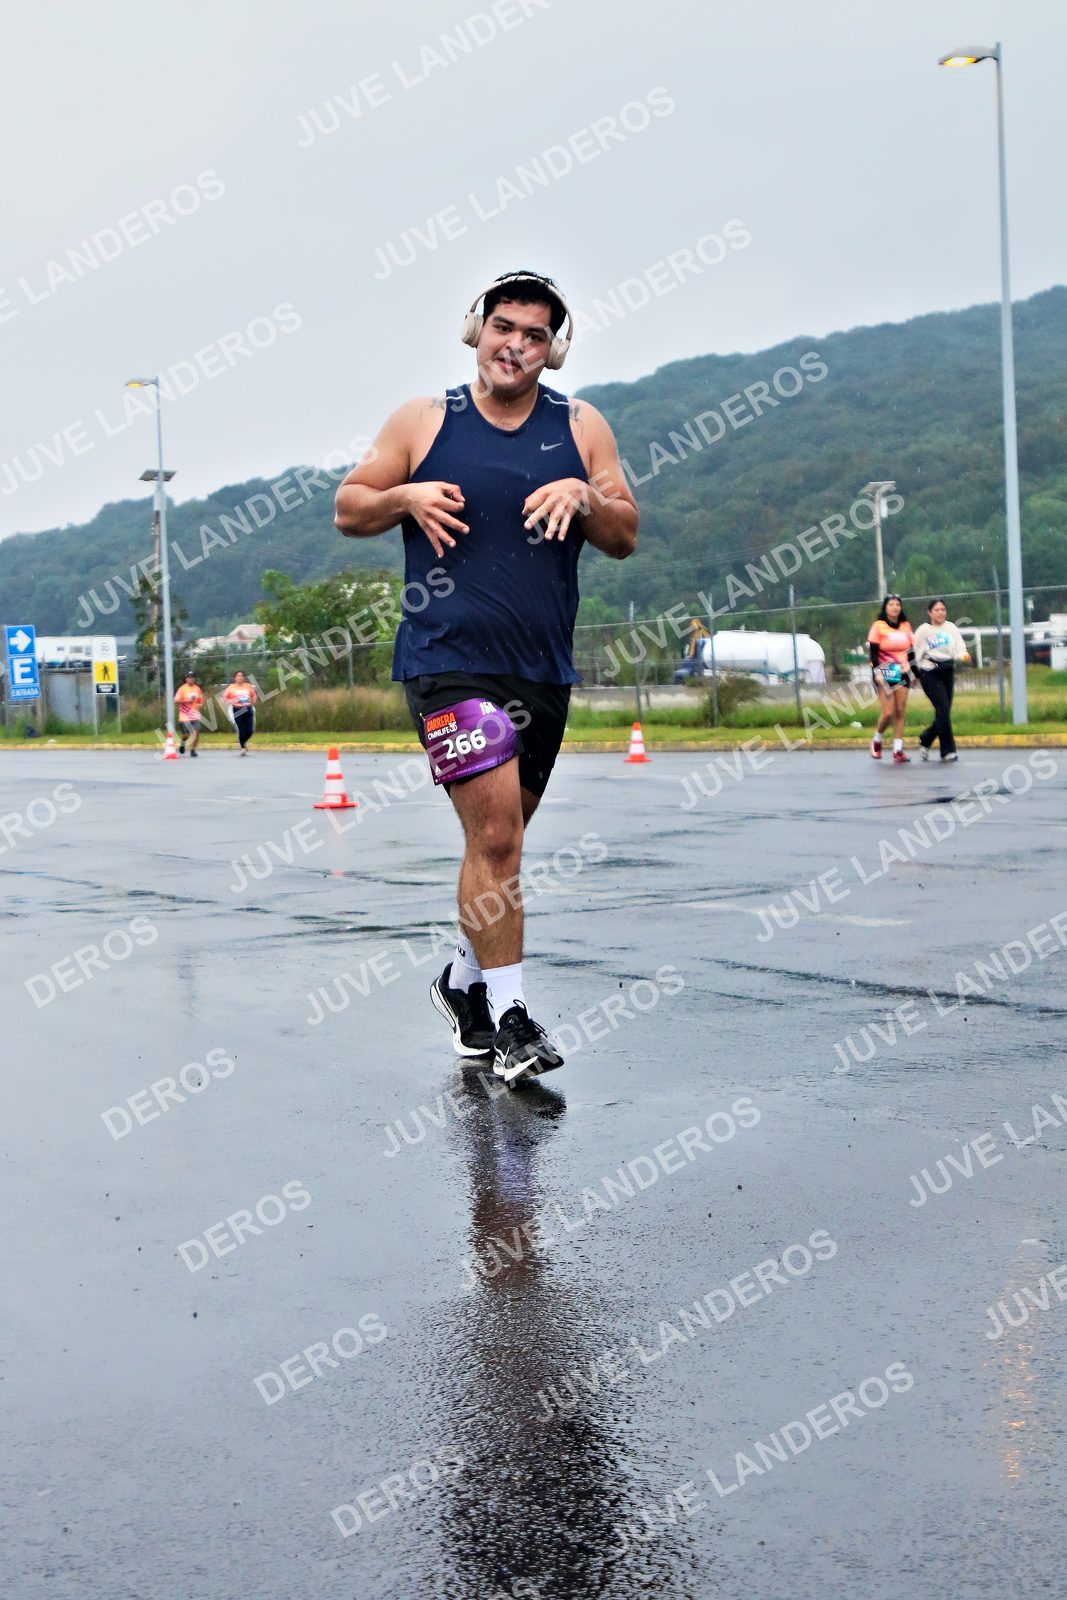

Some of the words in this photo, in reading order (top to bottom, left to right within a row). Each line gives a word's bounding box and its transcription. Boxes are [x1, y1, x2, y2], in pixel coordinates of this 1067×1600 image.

[13, 657, 34, 684] E
[426, 712, 456, 732] CARRERA
[442, 728, 487, 760] 266
